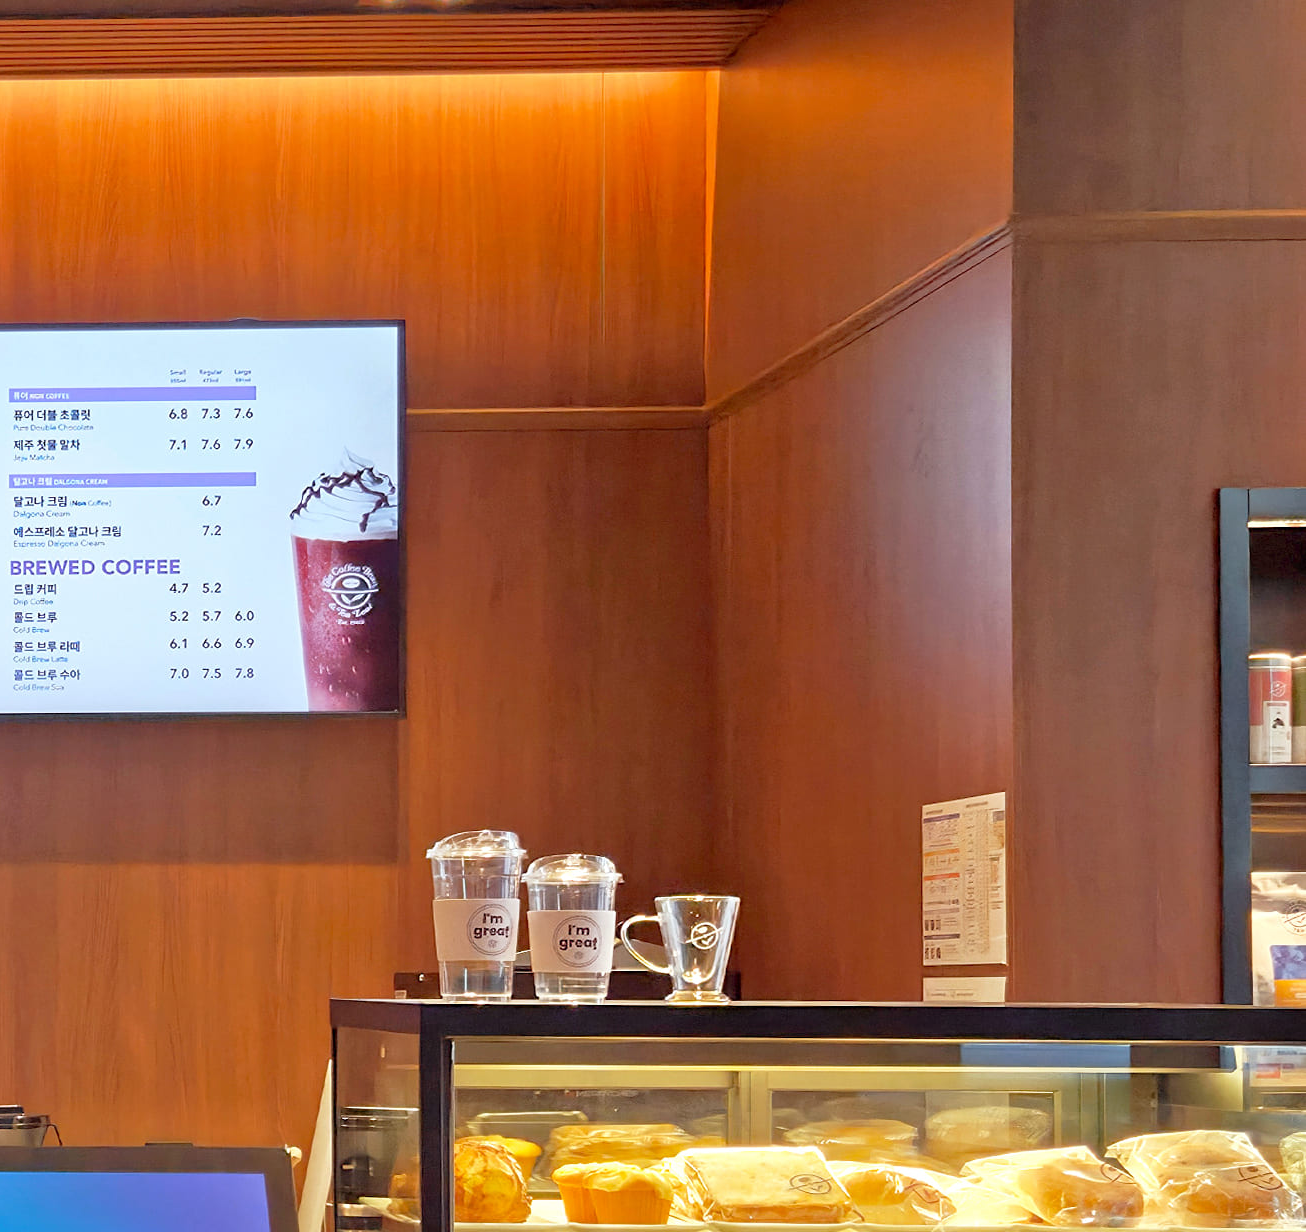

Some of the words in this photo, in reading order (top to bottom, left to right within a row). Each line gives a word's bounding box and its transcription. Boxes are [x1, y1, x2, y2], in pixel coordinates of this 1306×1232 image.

[10, 560, 95, 575] BREWED
[102, 559, 180, 575] COFFEE
[14, 612, 34, 623] 콜드
[37, 612, 57, 623] 브루
[170, 611, 189, 621] 5.2
[202, 611, 221, 621] 5.7
[235, 611, 254, 621] 6.0
[483, 913, 502, 924] I'm
[474, 925, 509, 939] great
[568, 925, 589, 936] I'm
[559, 937, 597, 950] great
